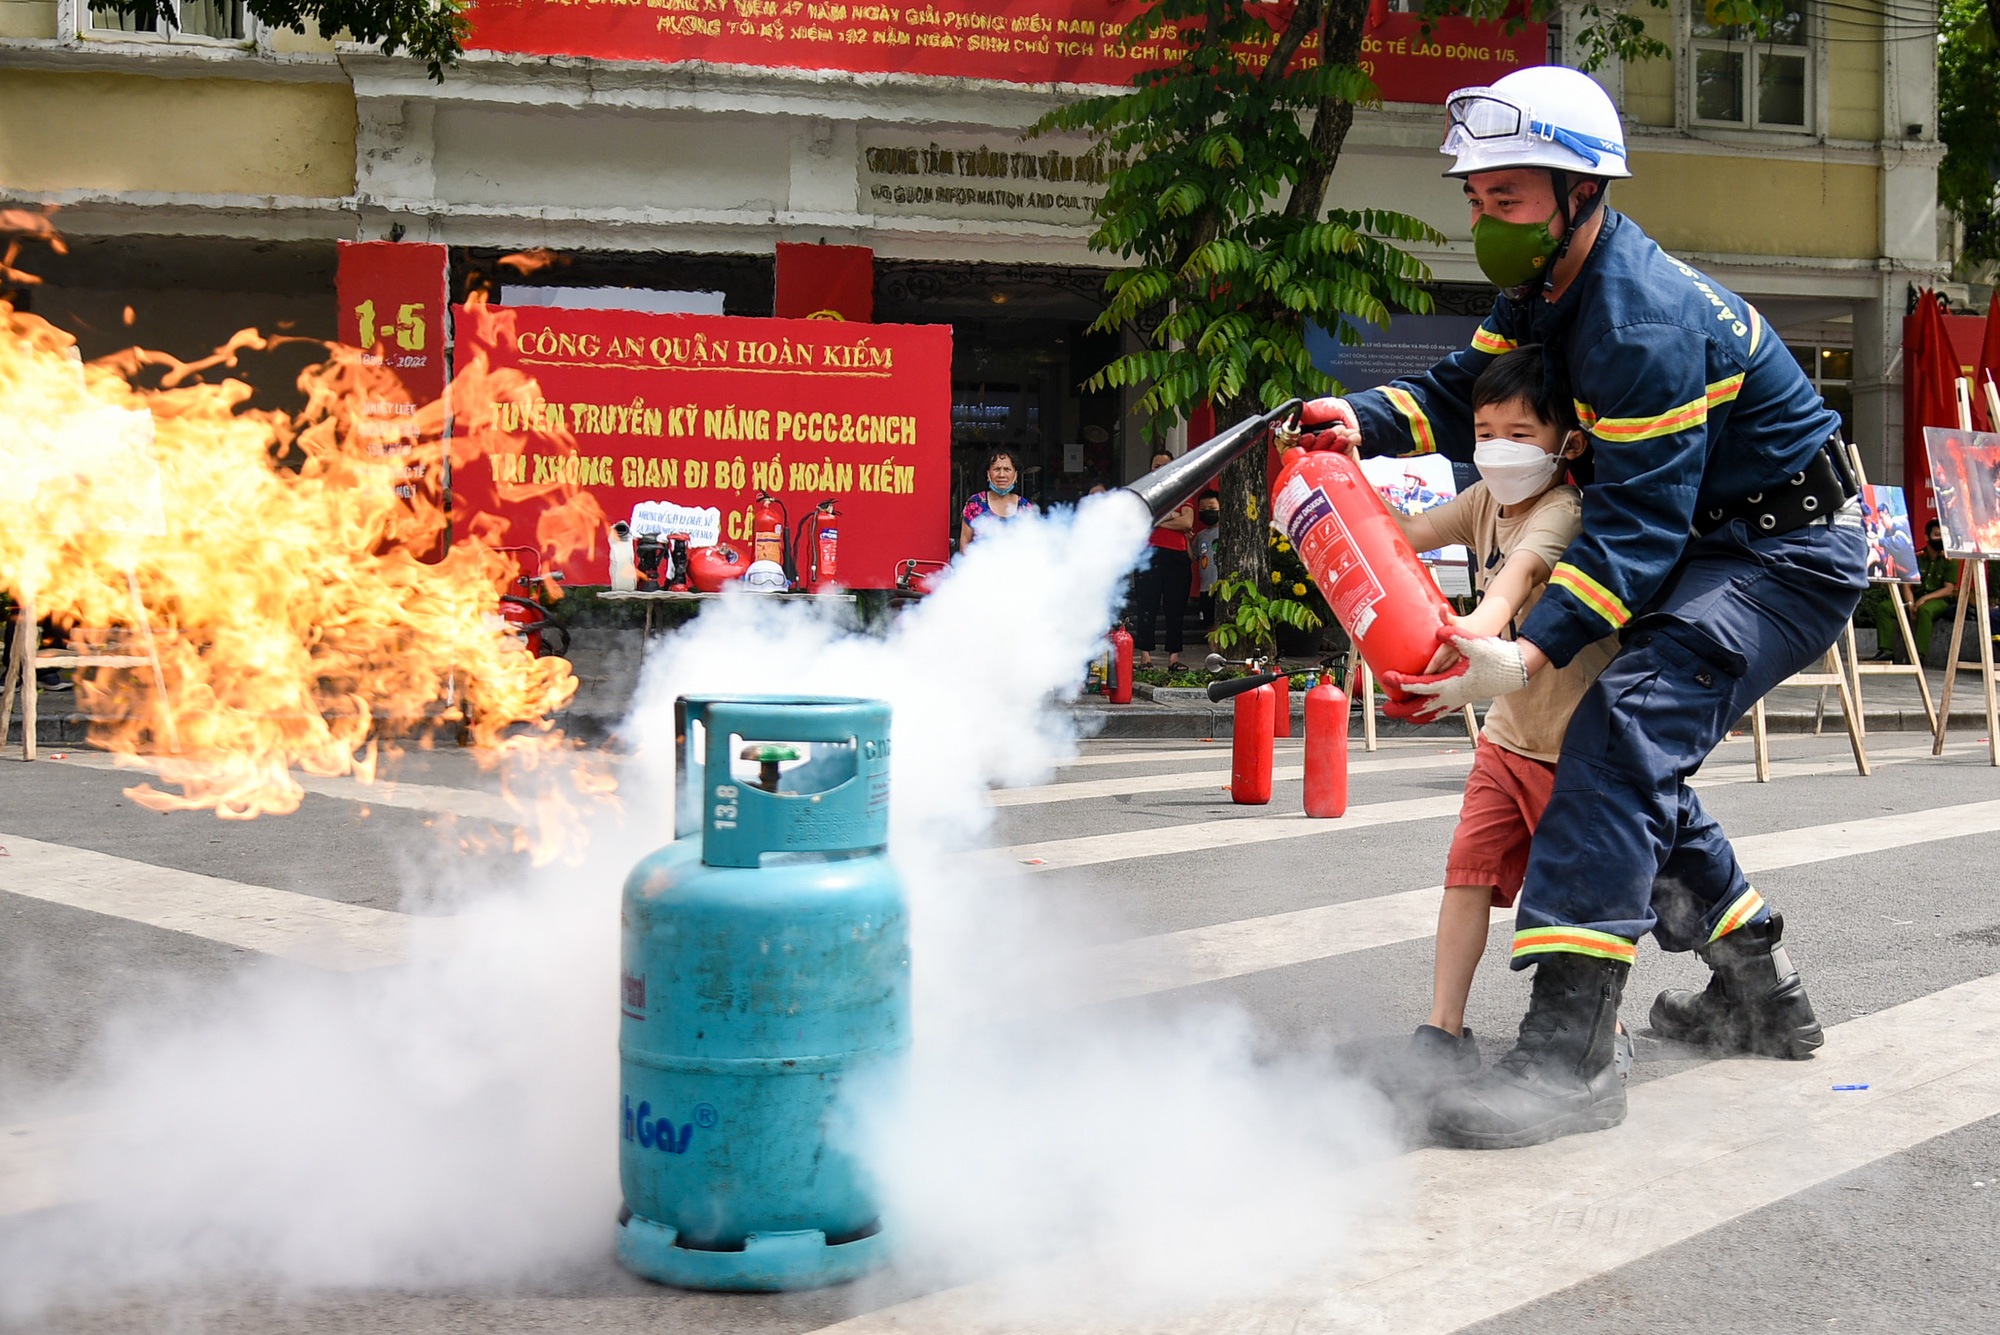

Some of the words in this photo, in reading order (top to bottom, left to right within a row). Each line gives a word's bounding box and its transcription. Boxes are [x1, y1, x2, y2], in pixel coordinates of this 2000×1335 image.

[852, 3, 900, 21] NGÀY
[1057, 19, 1095, 35] NAM
[1385, 37, 1406, 54] TẾ
[1411, 42, 1442, 57] LAO
[1446, 43, 1490, 61] ĐỘNG
[915, 32, 963, 48] NGÀY
[966, 34, 1010, 53] SINH
[1014, 35, 1050, 54] CHỦ
[1055, 41, 1094, 57] TỊCH
[1129, 43, 1159, 60] CHÍ
[936, 186, 1026, 209] INFORMATION
[1027, 192, 1055, 209] AND
[1056, 195, 1098, 212] CULTU
[354, 299, 426, 350] 1-5
[516, 326, 600, 358] CÔNG
[606, 336, 646, 359] AN
[649, 333, 730, 367] QUẬN
[737, 337, 813, 365] HOÀN
[822, 337, 893, 369] KIẾM
[489, 398, 565, 433] TUYÊN
[570, 396, 662, 437] TRUYỀN
[668, 403, 698, 437] KỸ
[703, 403, 769, 441] NĂNG
[776, 410, 917, 445] PCCC&CNCH
[489, 453, 526, 488] TẠI
[533, 449, 615, 487] KHÔNG
[621, 456, 679, 488] GIAN
[684, 458, 709, 489] ĐI
[714, 455, 746, 496] BỘ
[752, 452, 784, 492] HỒ
[788, 456, 854, 493] HOÀN
[858, 456, 915, 494] KIẾM
[728, 504, 755, 546] CẬ
